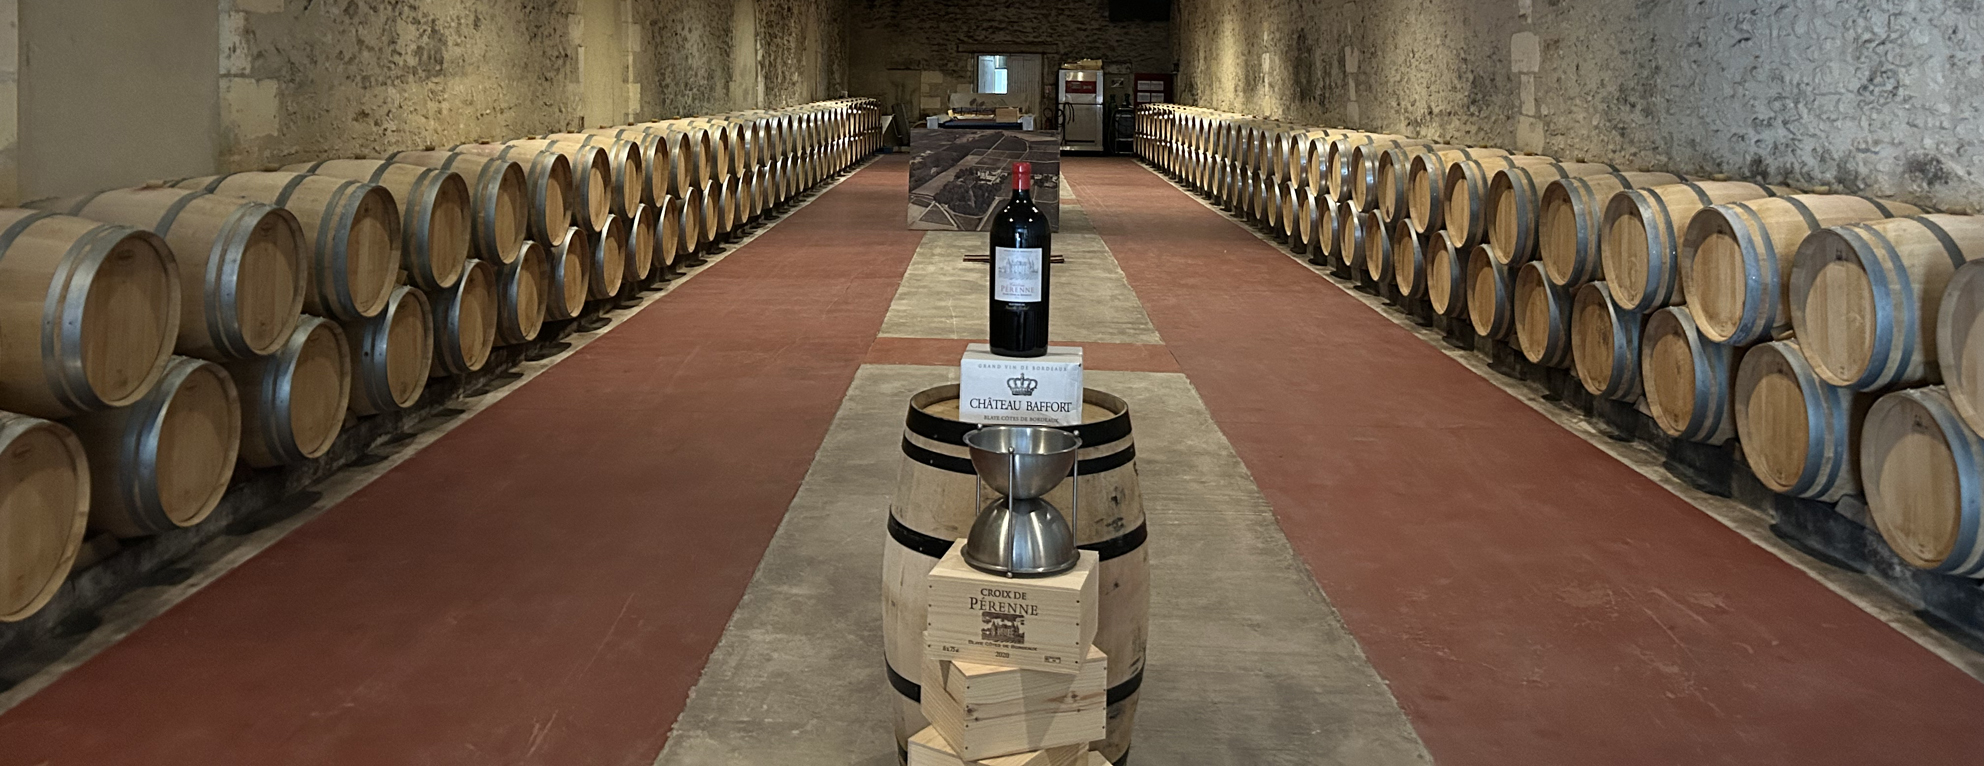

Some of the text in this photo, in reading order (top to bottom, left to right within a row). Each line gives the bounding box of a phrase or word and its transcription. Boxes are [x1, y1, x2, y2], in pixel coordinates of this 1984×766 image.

[970, 396, 1072, 413] CHÂTEAU BAFFORT
[980, 588, 1027, 600] CROIX DE
[969, 596, 1038, 616] PÉRENNE
